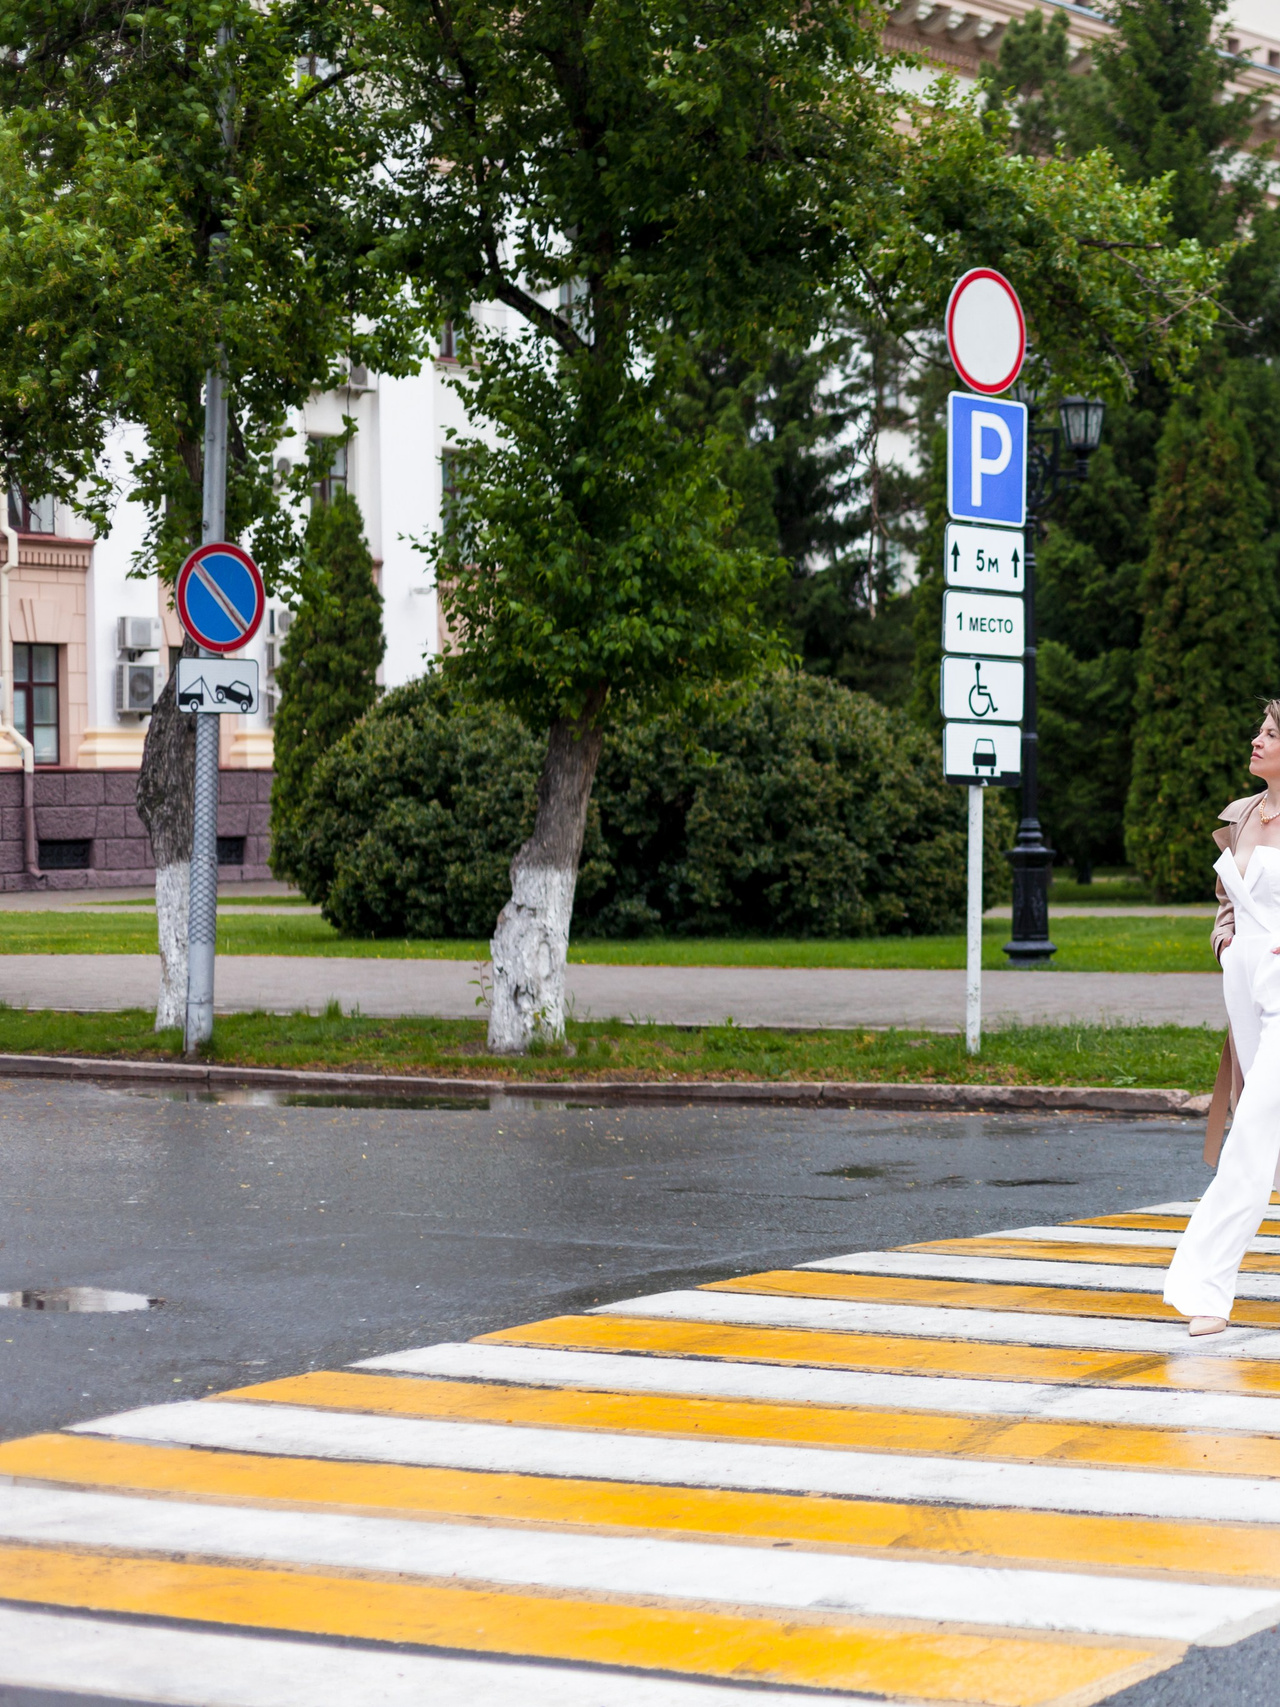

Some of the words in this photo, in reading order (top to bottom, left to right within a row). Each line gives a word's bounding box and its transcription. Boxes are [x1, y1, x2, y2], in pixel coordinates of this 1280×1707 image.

[971, 410, 1012, 507] P
[956, 611, 963, 631] 1
[969, 617, 1013, 634] МЕСТО
